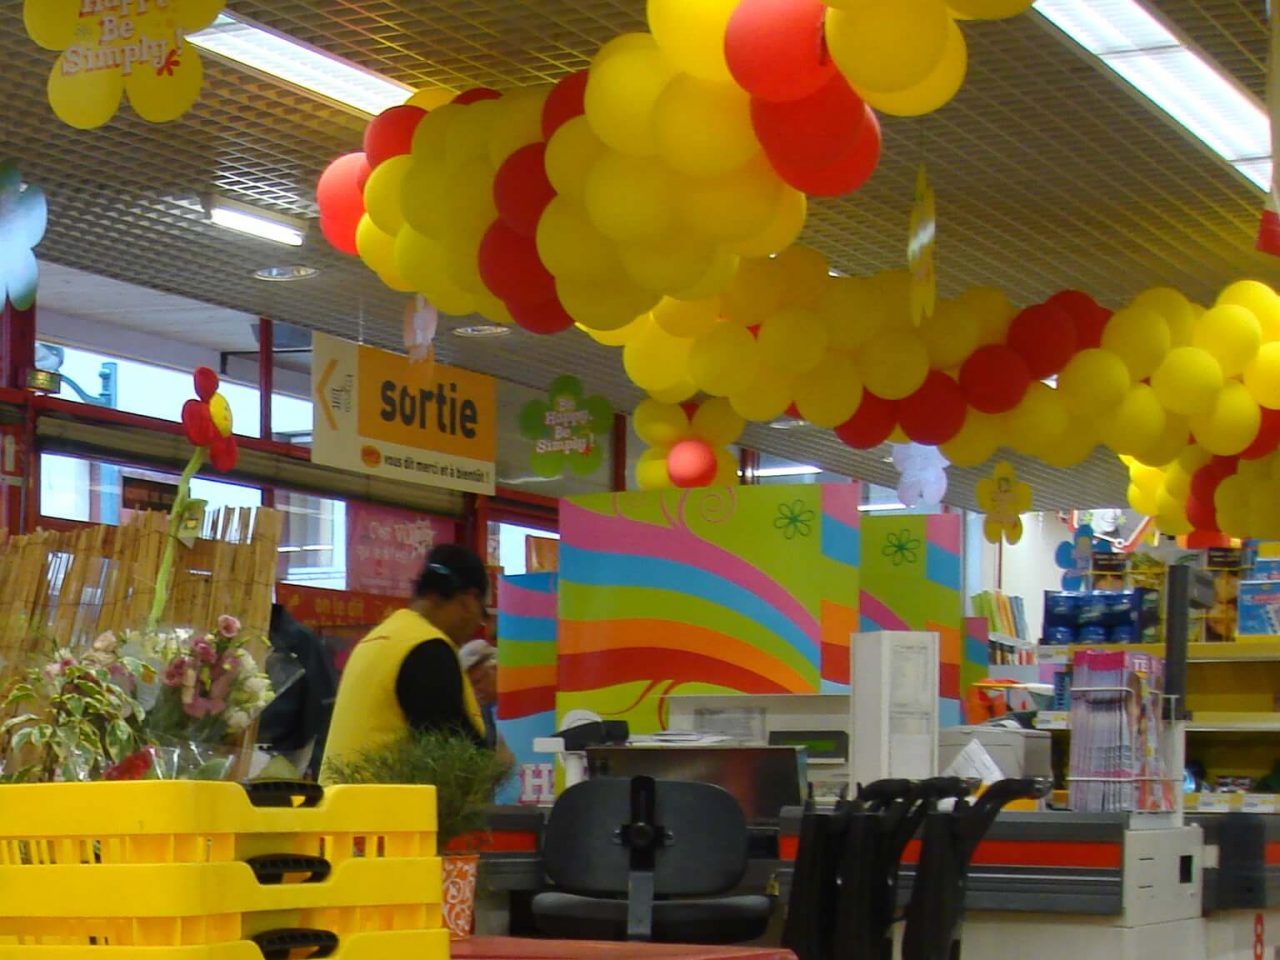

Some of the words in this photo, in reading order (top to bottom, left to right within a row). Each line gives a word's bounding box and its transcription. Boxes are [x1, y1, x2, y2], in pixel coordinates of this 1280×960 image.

[99, 15, 135, 44] Be
[61, 35, 168, 76] Simply
[380, 379, 478, 440] sortie
